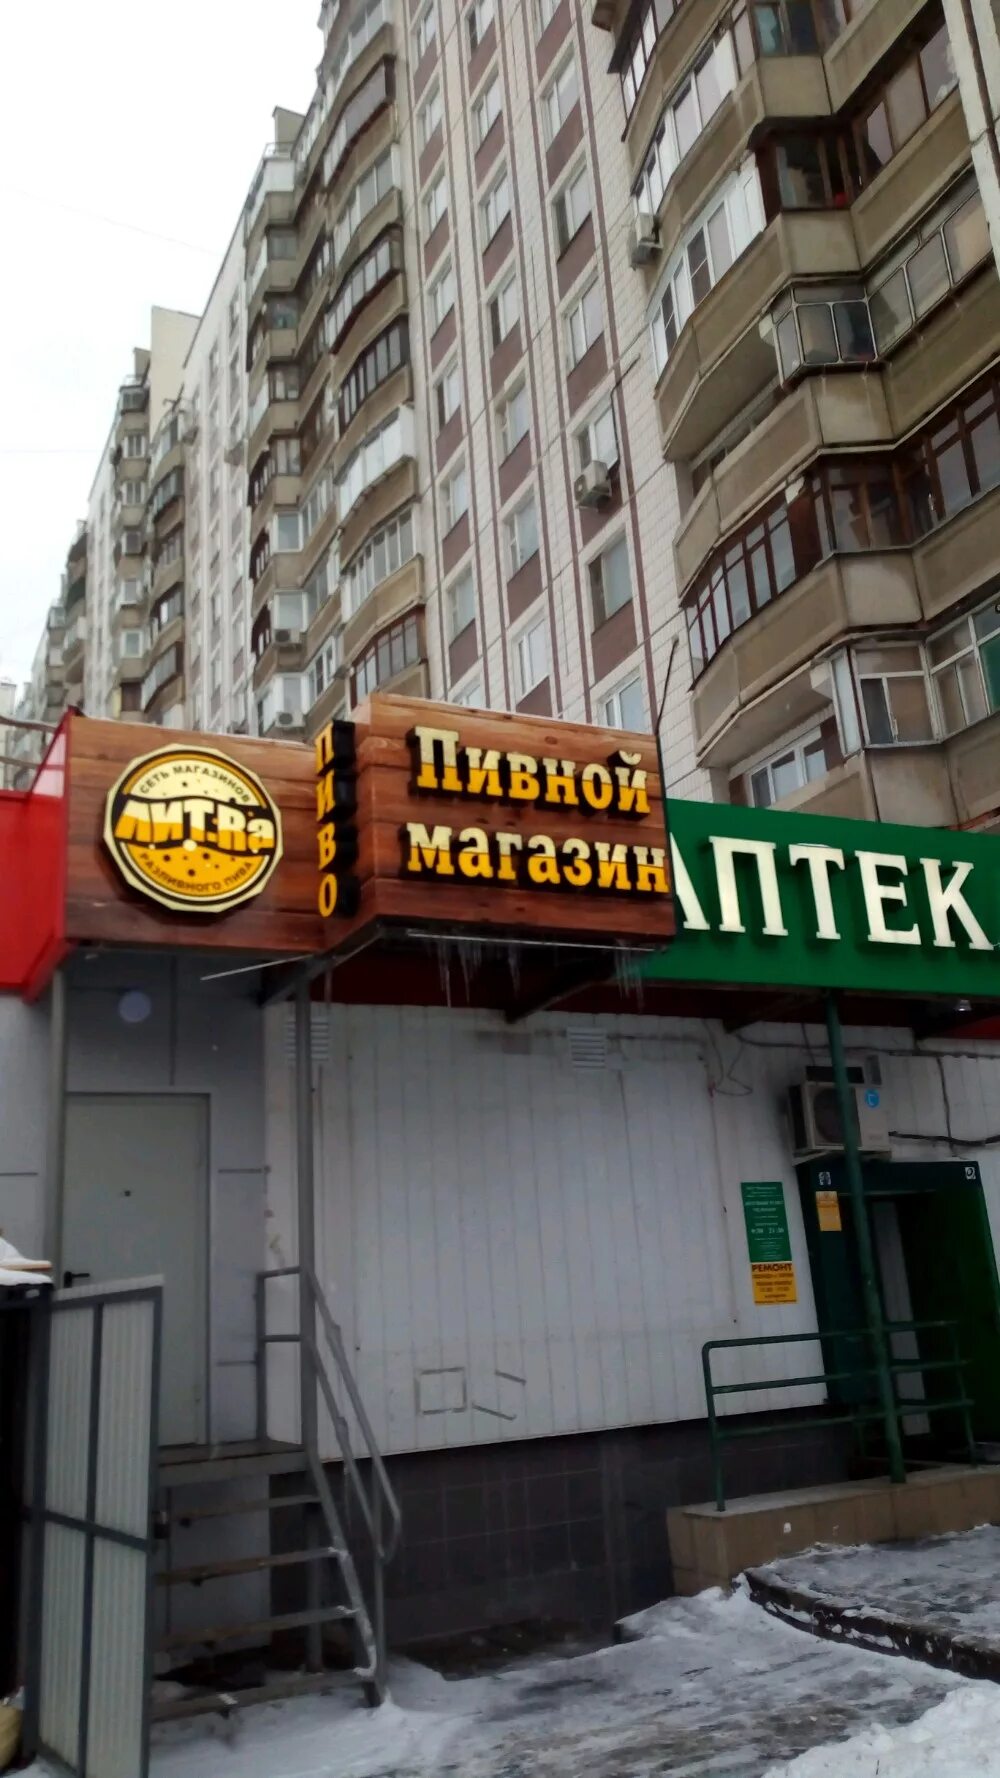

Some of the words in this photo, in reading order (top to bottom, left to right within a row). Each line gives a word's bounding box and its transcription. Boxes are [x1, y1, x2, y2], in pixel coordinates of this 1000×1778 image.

[140, 771, 170, 795] СЕТЬ
[173, 764, 252, 803] МАГАЗИНОВ
[414, 726, 651, 814] Пивной
[315, 722, 337, 917] ПИВО
[140, 852, 222, 893] РАЗЛИВНОГО
[225, 861, 253, 887] ПИВА
[406, 822, 671, 893] магазин
[752, 1263, 792, 1272] РЕМОНТ
